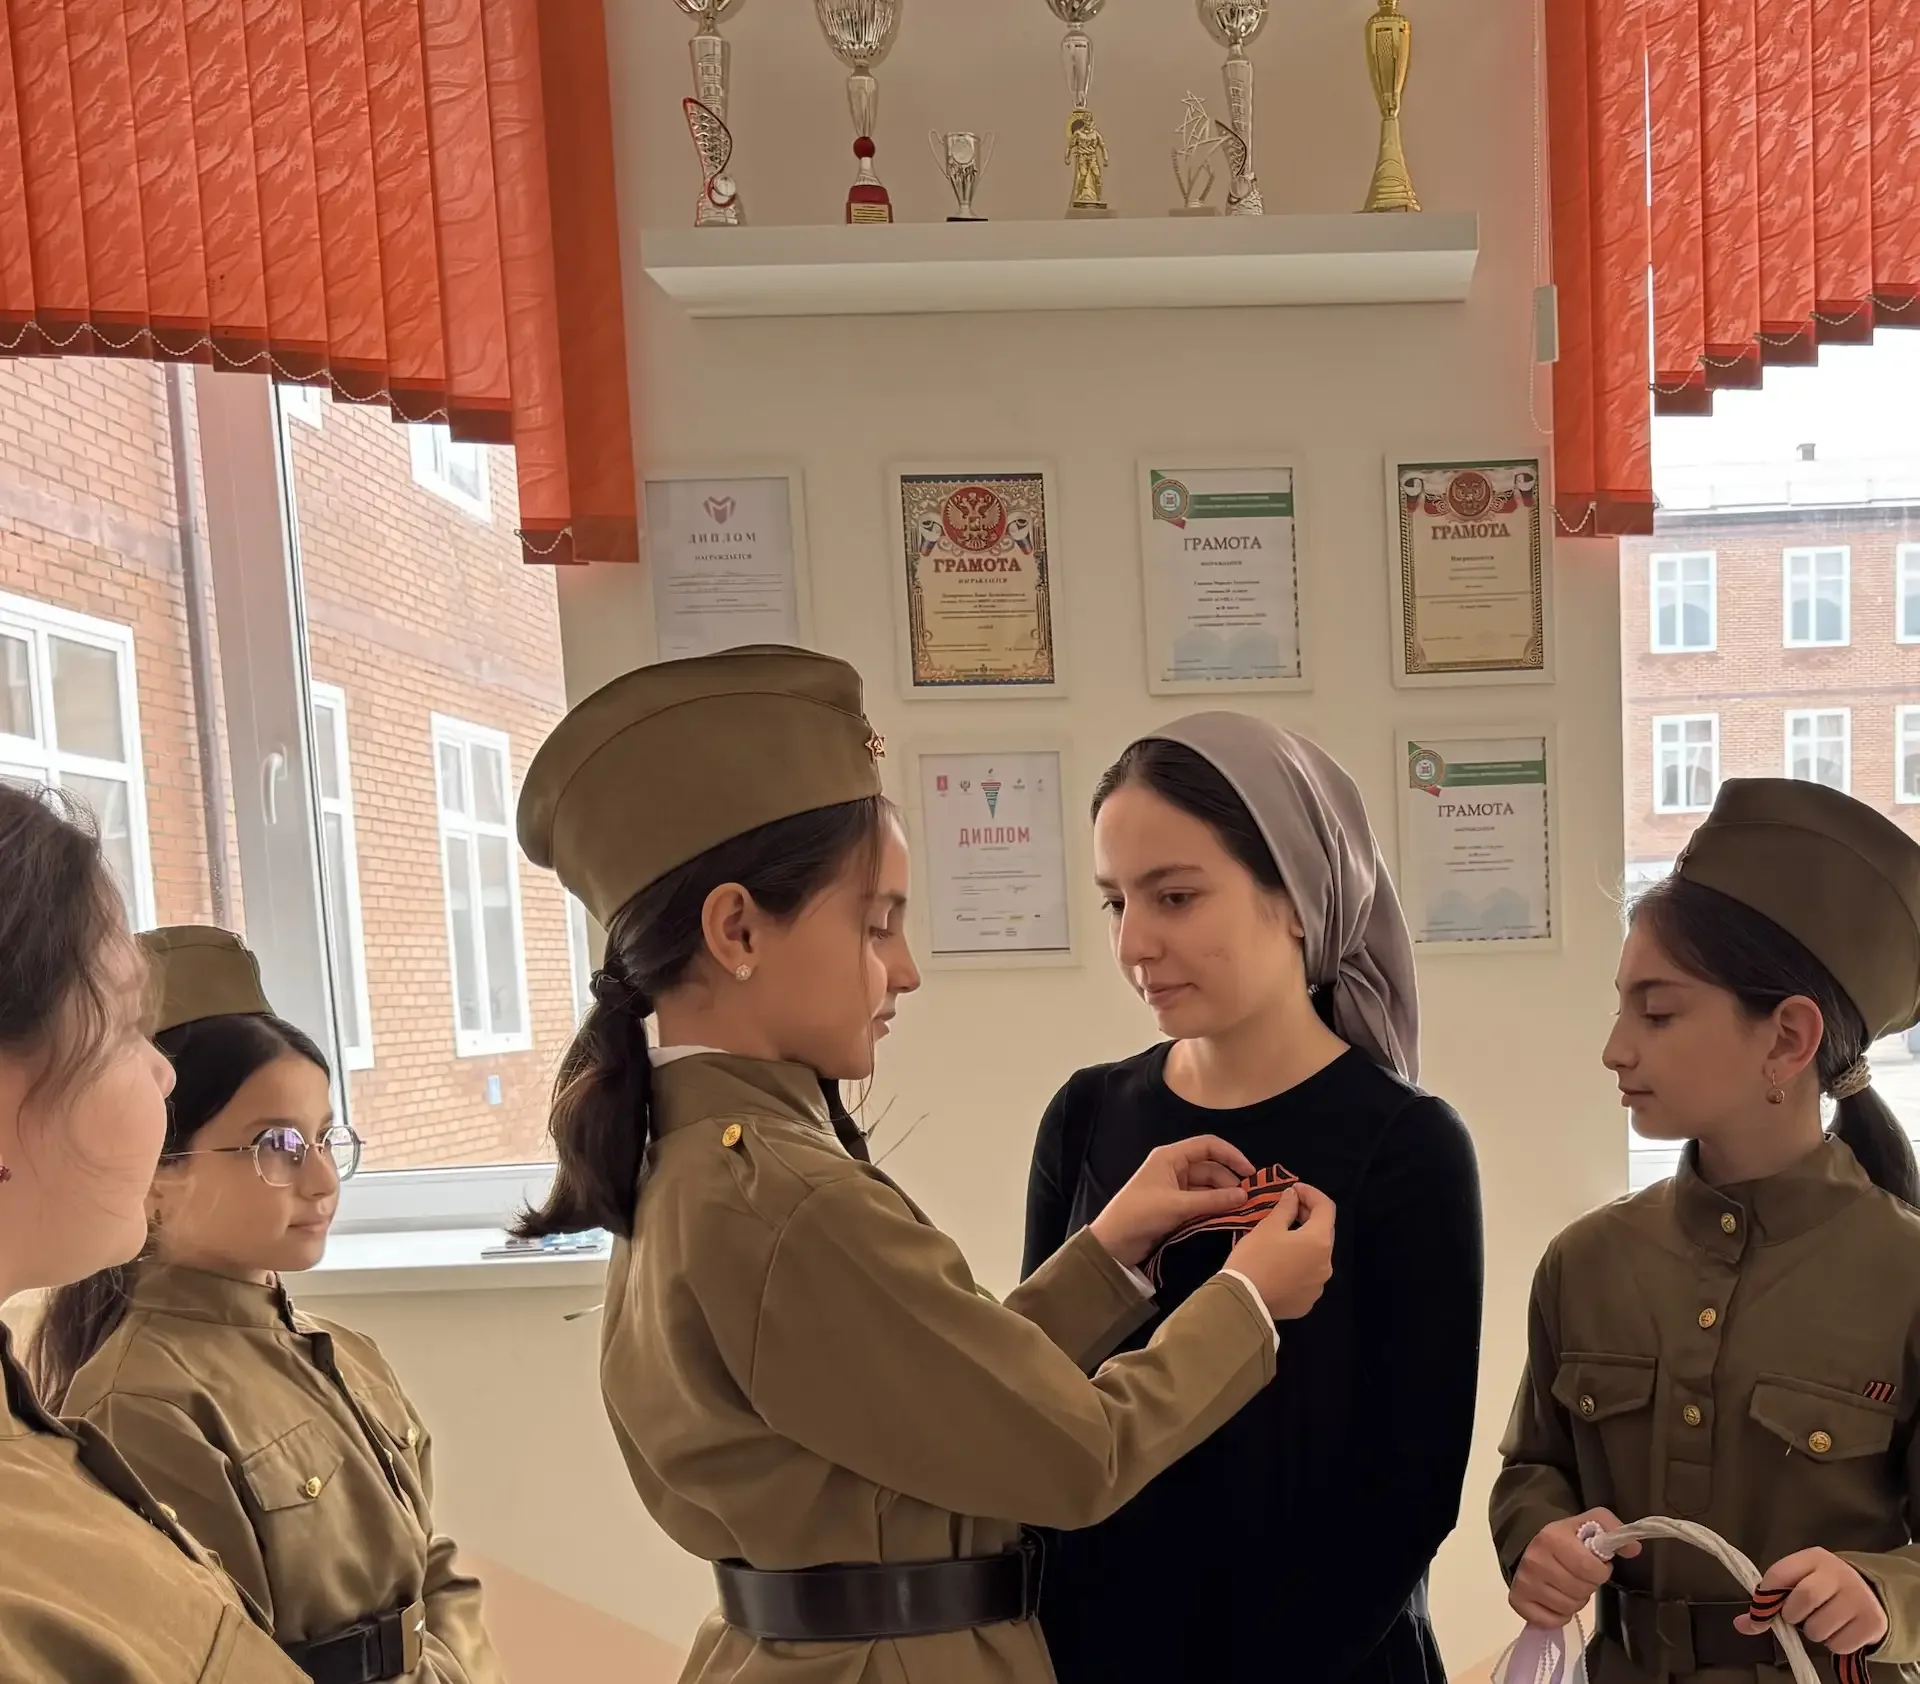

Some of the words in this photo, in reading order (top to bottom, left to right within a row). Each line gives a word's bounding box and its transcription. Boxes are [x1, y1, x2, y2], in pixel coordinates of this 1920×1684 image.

[688, 531, 757, 545] ДИПЛОМ
[1431, 523, 1511, 540] ГРАМОТА
[1183, 536, 1262, 551] ГРАМОТА
[933, 557, 1022, 574] ГРАМОТА
[1438, 802, 1515, 818] ГРАМОТА
[958, 827, 1030, 847] ДИПЛОМ
